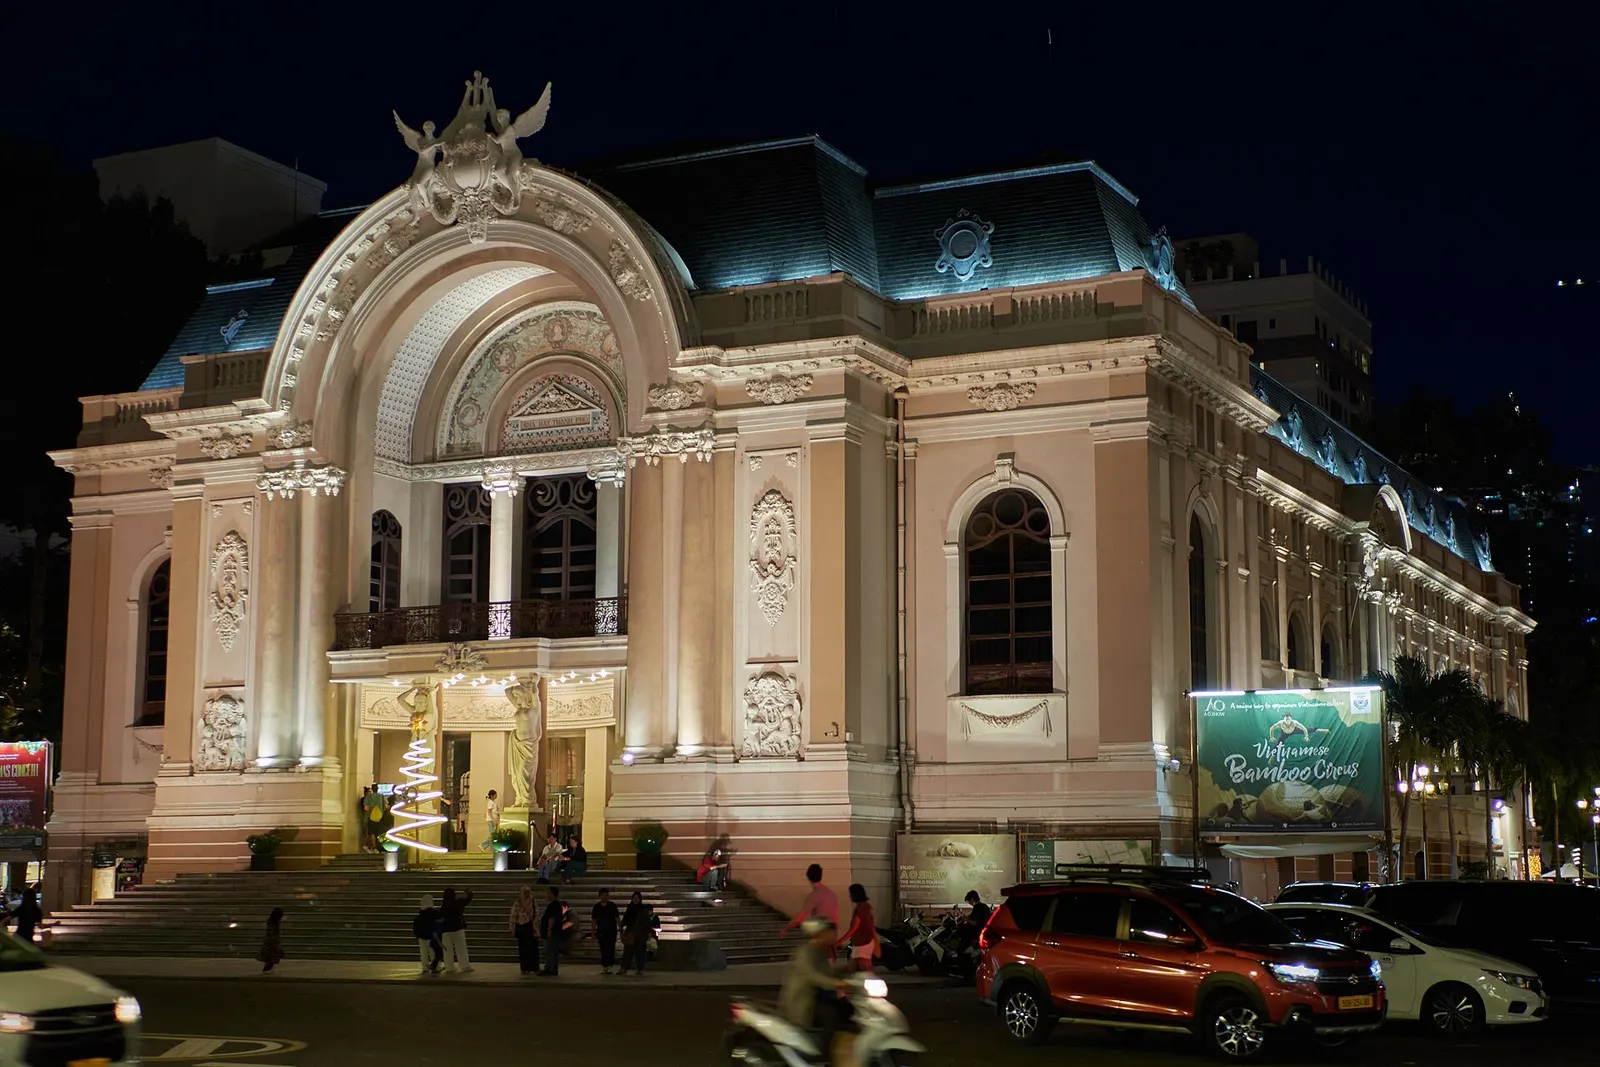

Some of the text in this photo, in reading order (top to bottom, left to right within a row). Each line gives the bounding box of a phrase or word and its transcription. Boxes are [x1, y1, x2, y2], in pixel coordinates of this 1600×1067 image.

[1230, 702, 1236, 710] A
[1236, 702, 1252, 712] unique
[1253, 703, 1264, 712] way
[1253, 739, 1330, 763] Vietnamese
[11, 763, 40, 778] CONCERT
[1224, 754, 1360, 784] Bamboo Circus
